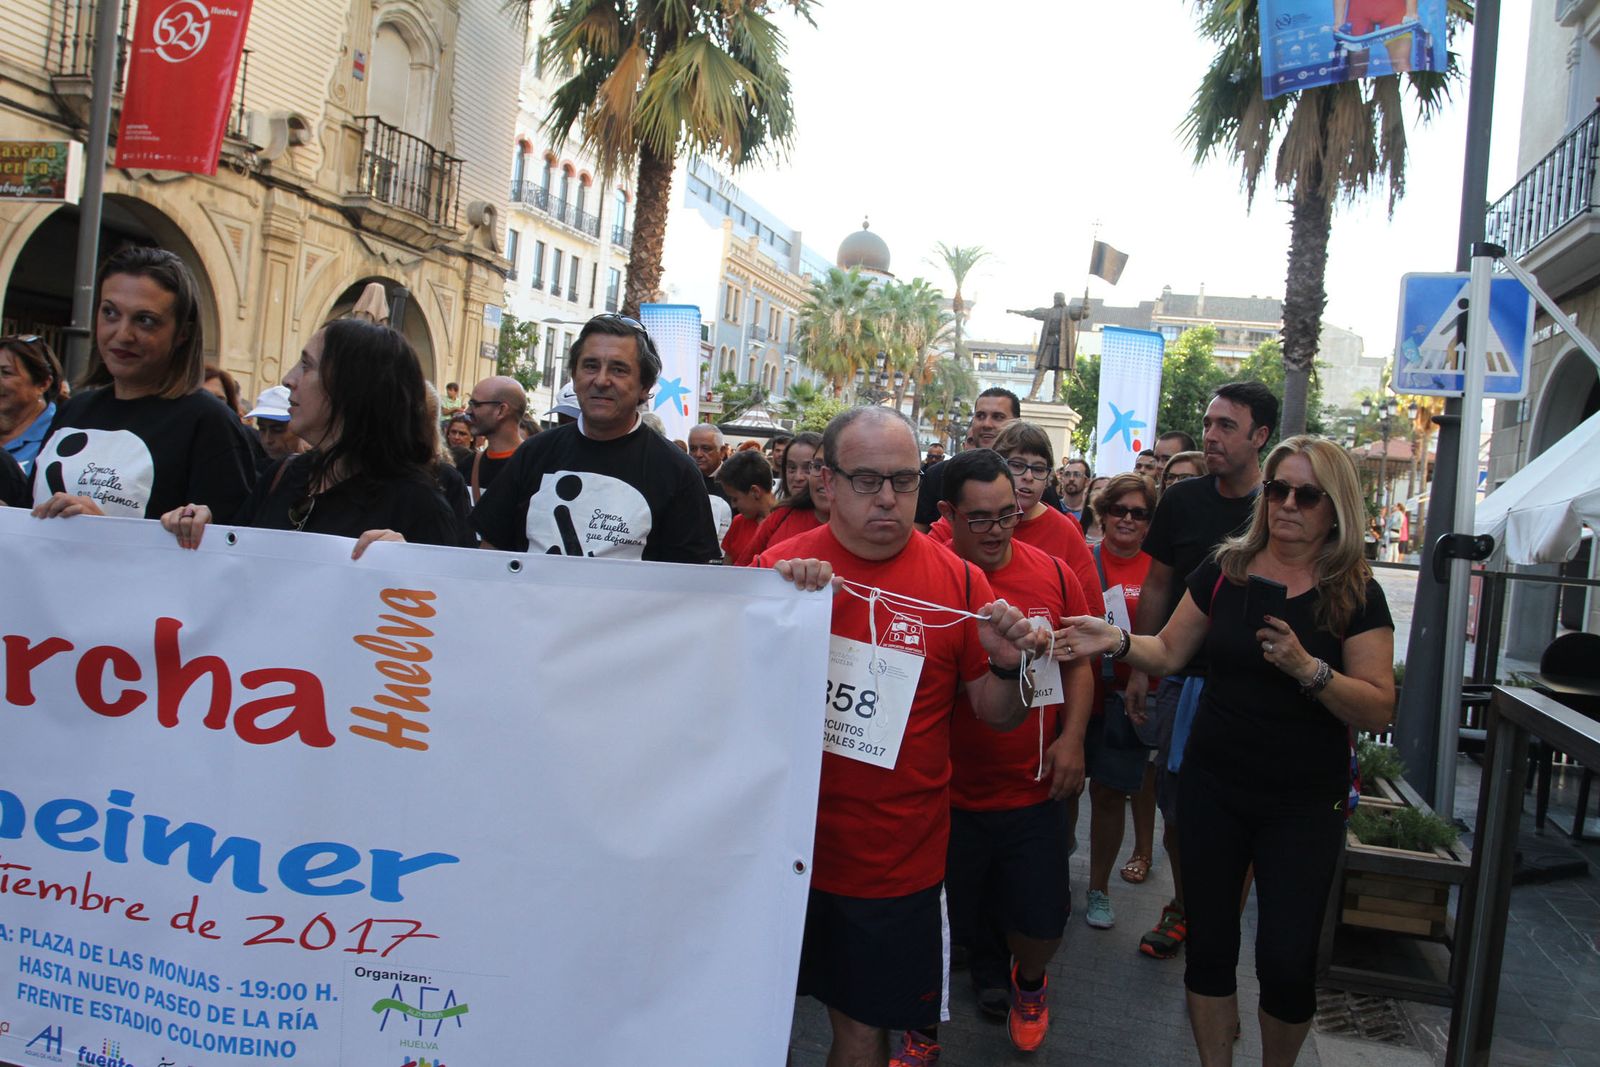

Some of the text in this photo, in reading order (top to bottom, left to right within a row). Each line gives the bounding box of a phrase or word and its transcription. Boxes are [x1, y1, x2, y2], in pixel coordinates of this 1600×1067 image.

[83, 462, 117, 475] Somos
[592, 508, 623, 522] Somos
[589, 520, 629, 534] la huella
[586, 530, 643, 546] que dejamos
[349, 588, 437, 751] Huelva
[1034, 688, 1053, 697] 2017
[858, 742, 886, 757] 2017
[170, 895, 221, 939] de
[243, 912, 440, 957] 2017
[20, 927, 74, 956] PLAZA
[79, 941, 103, 963] DE
[109, 948, 143, 971] LAS
[149, 957, 220, 993] MONJAS
[240, 980, 307, 1001] 19:00
[315, 983, 338, 1002] H.
[354, 966, 432, 984] Organizan:
[19, 955, 318, 1030] HASTA NUEVO PASEO DE LA RÍA
[17, 982, 296, 1058] FRENTE ESTADIO COLOMBINO
[400, 1039, 439, 1050] HUELVA
